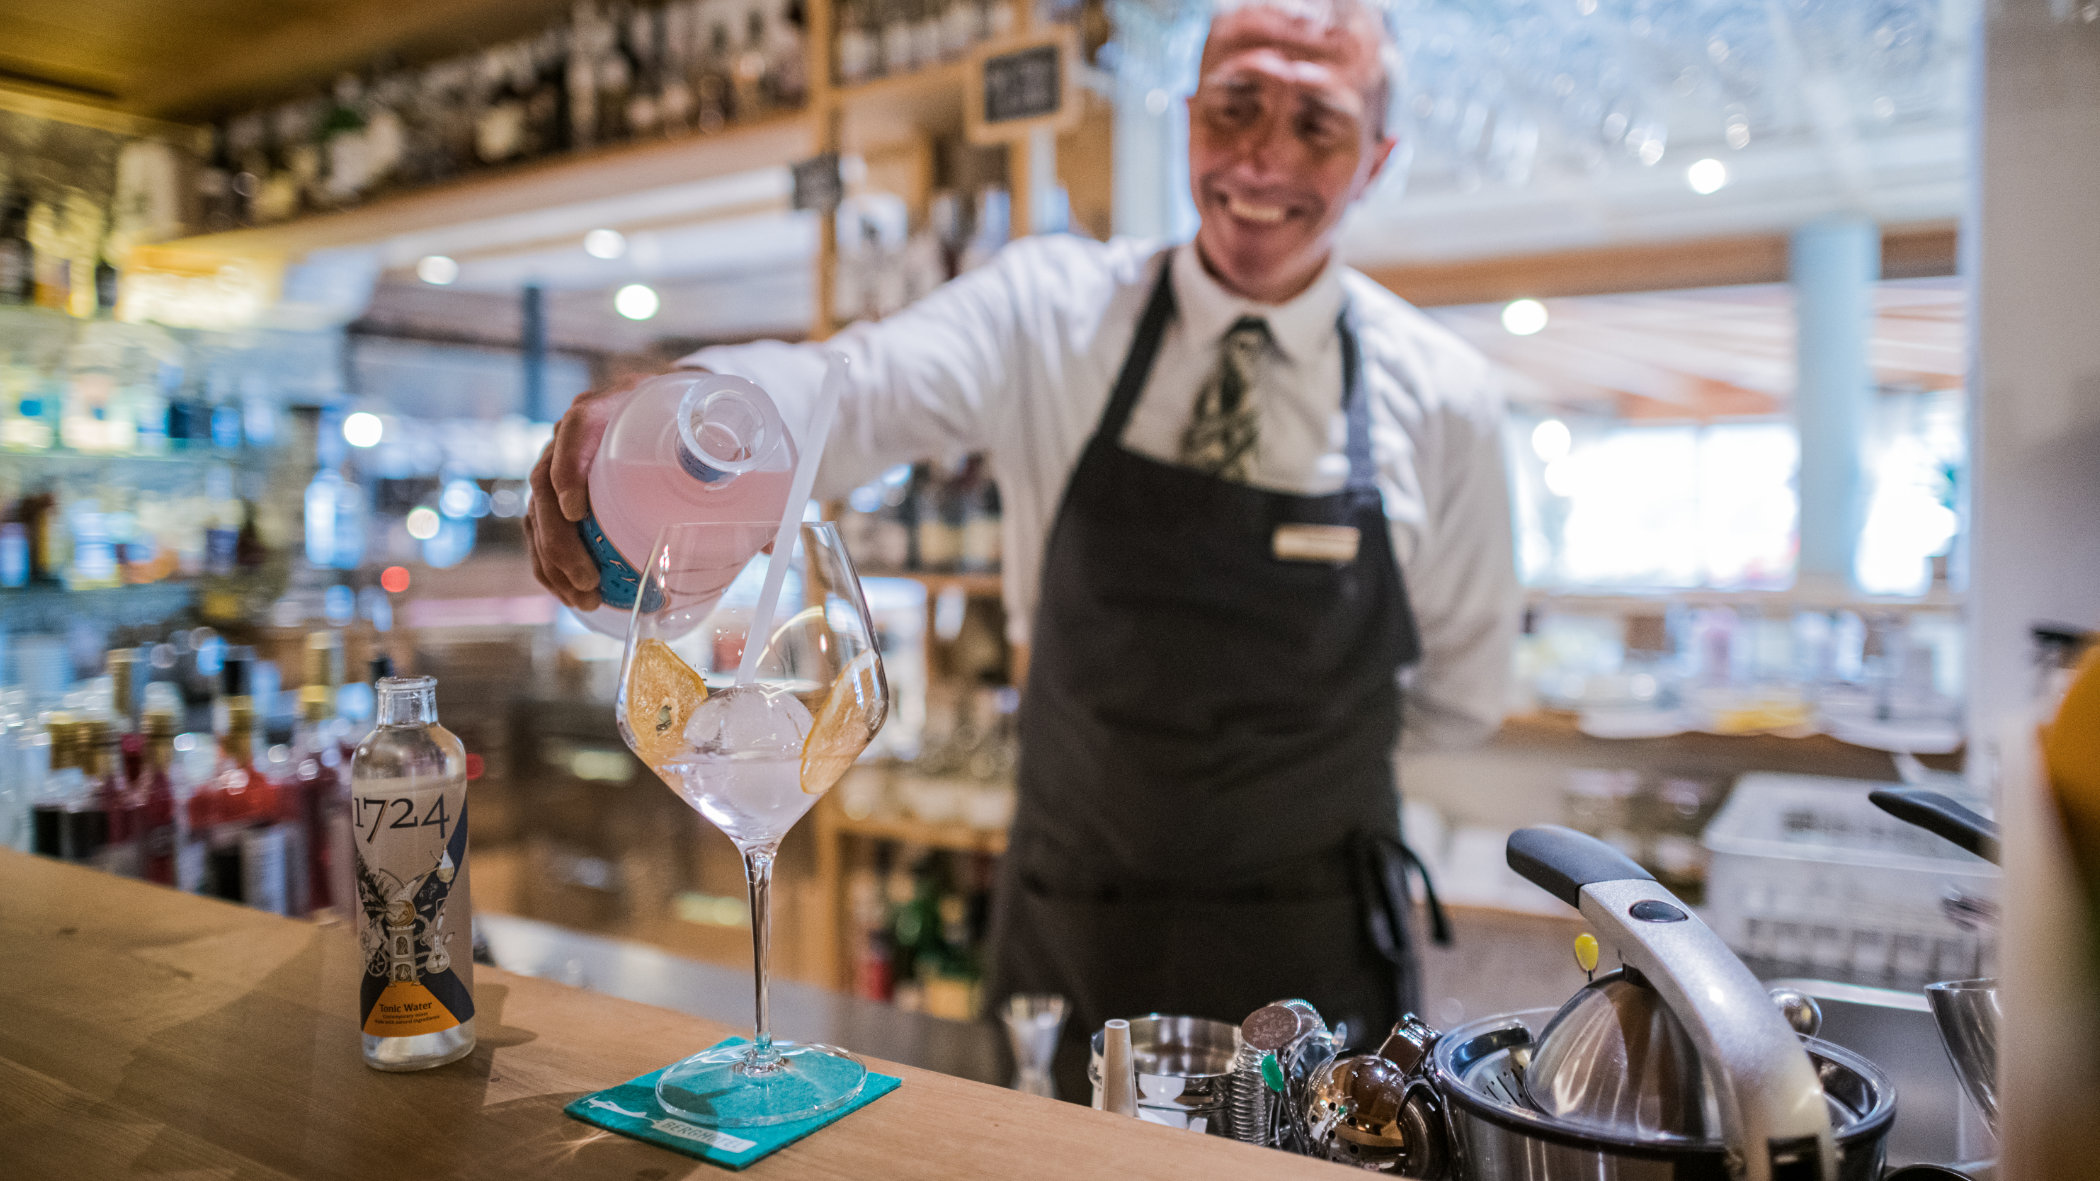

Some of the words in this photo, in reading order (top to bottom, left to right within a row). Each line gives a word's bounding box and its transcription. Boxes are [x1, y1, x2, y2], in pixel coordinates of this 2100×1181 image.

[354, 793, 450, 845] 1724
[379, 1003, 402, 1013] Tonic
[404, 1001, 432, 1012] Water
